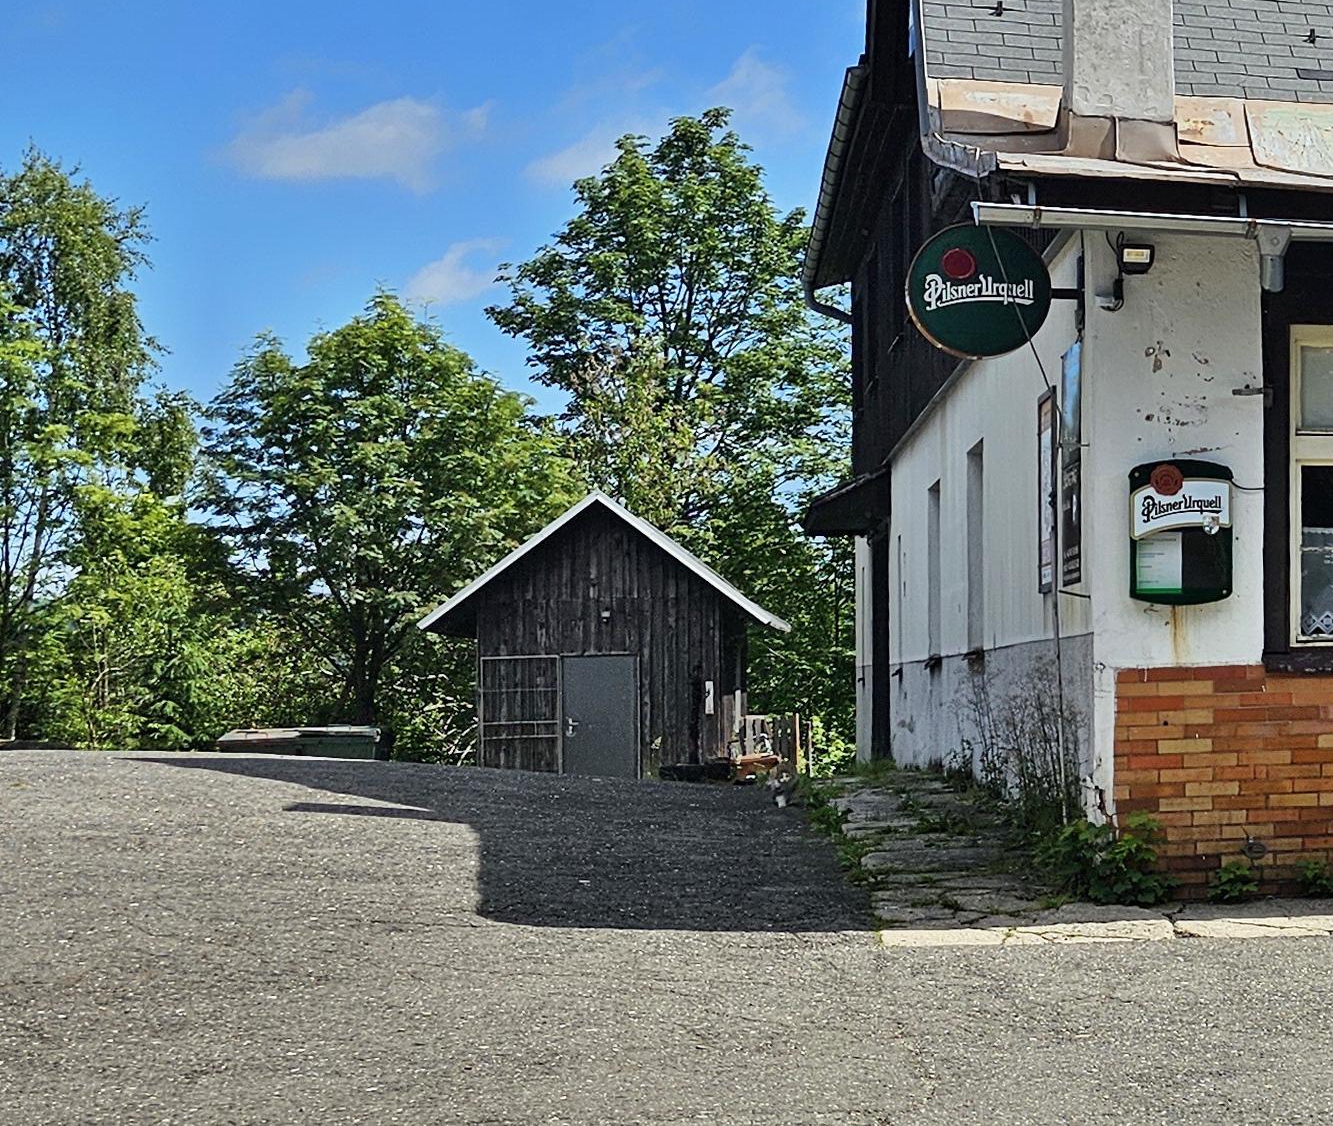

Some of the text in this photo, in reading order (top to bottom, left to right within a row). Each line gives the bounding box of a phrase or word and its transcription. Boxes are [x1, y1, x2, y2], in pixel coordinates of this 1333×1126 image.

[923, 273, 1034, 311] Pilsner Urquell
[1141, 494, 1222, 523] Pilsner Urquell
